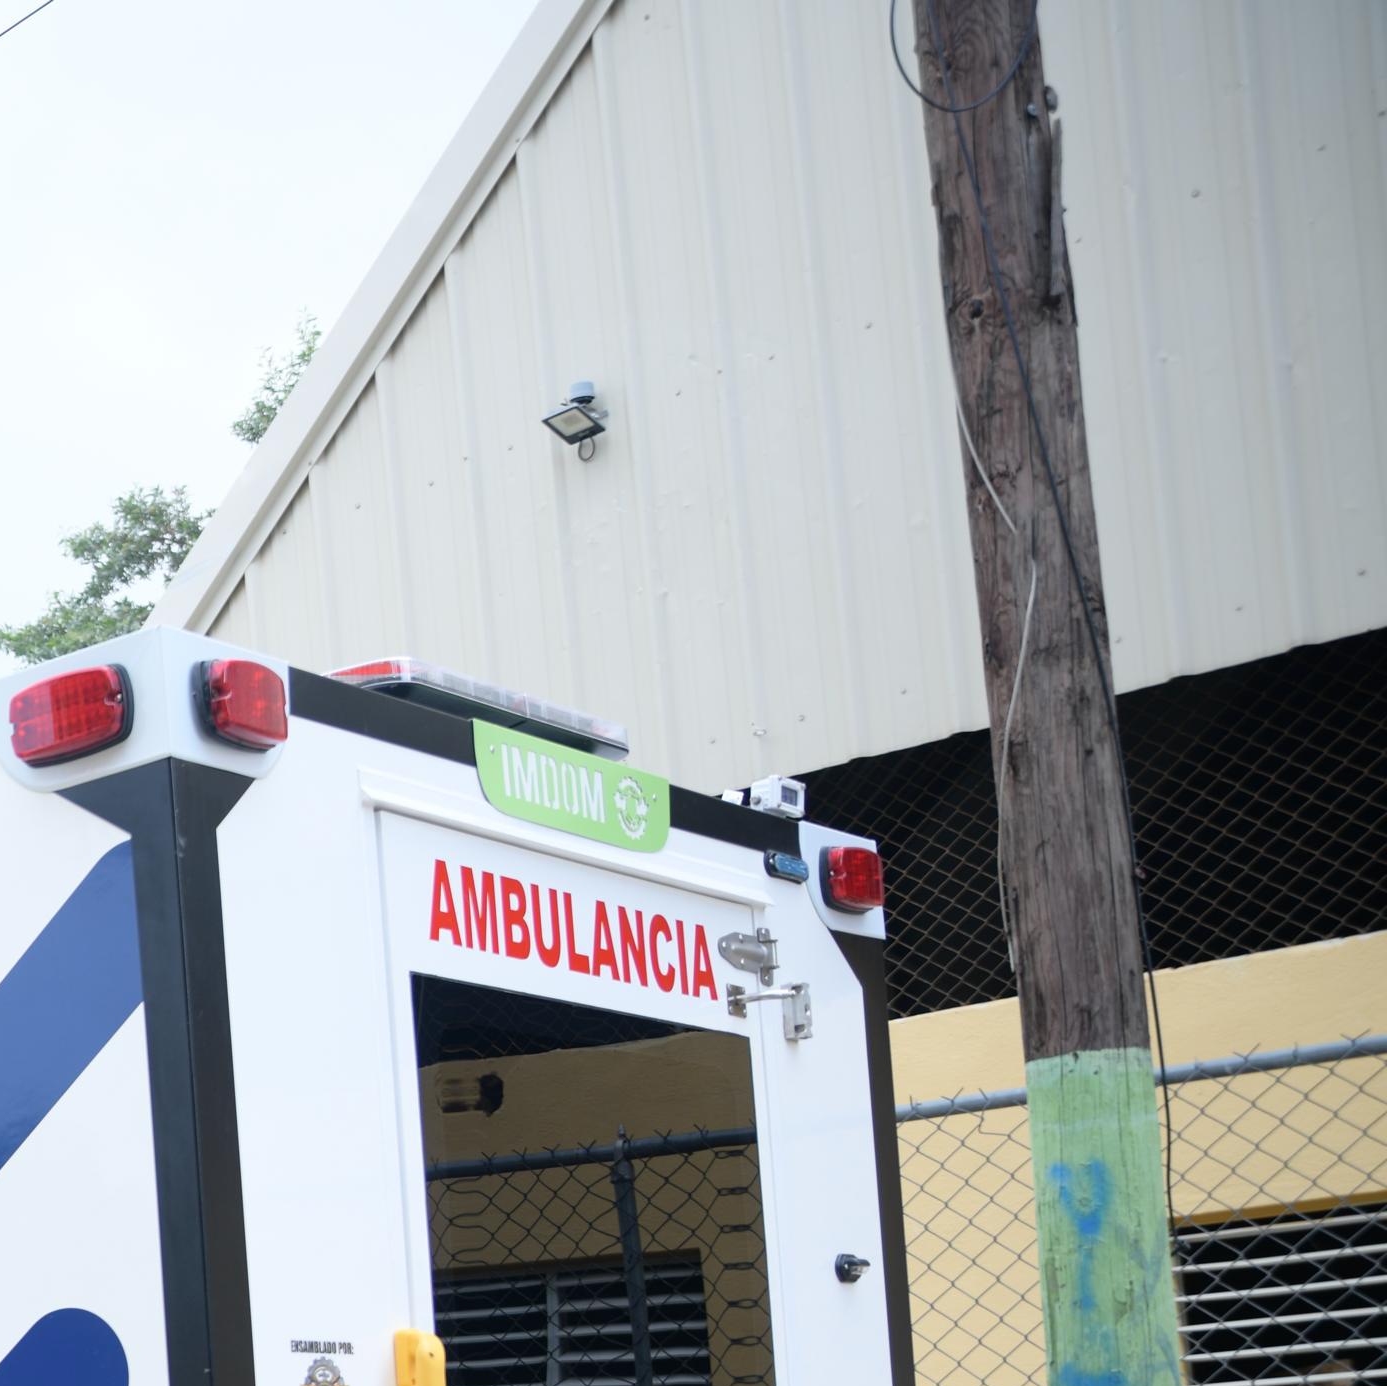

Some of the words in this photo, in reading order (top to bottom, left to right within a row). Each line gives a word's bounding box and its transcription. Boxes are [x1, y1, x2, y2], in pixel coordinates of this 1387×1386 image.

[501, 743, 606, 824] IMDOM
[430, 859, 719, 1001] AMBULANCIA
[291, 1341, 336, 1354] ENSAMBLADO
